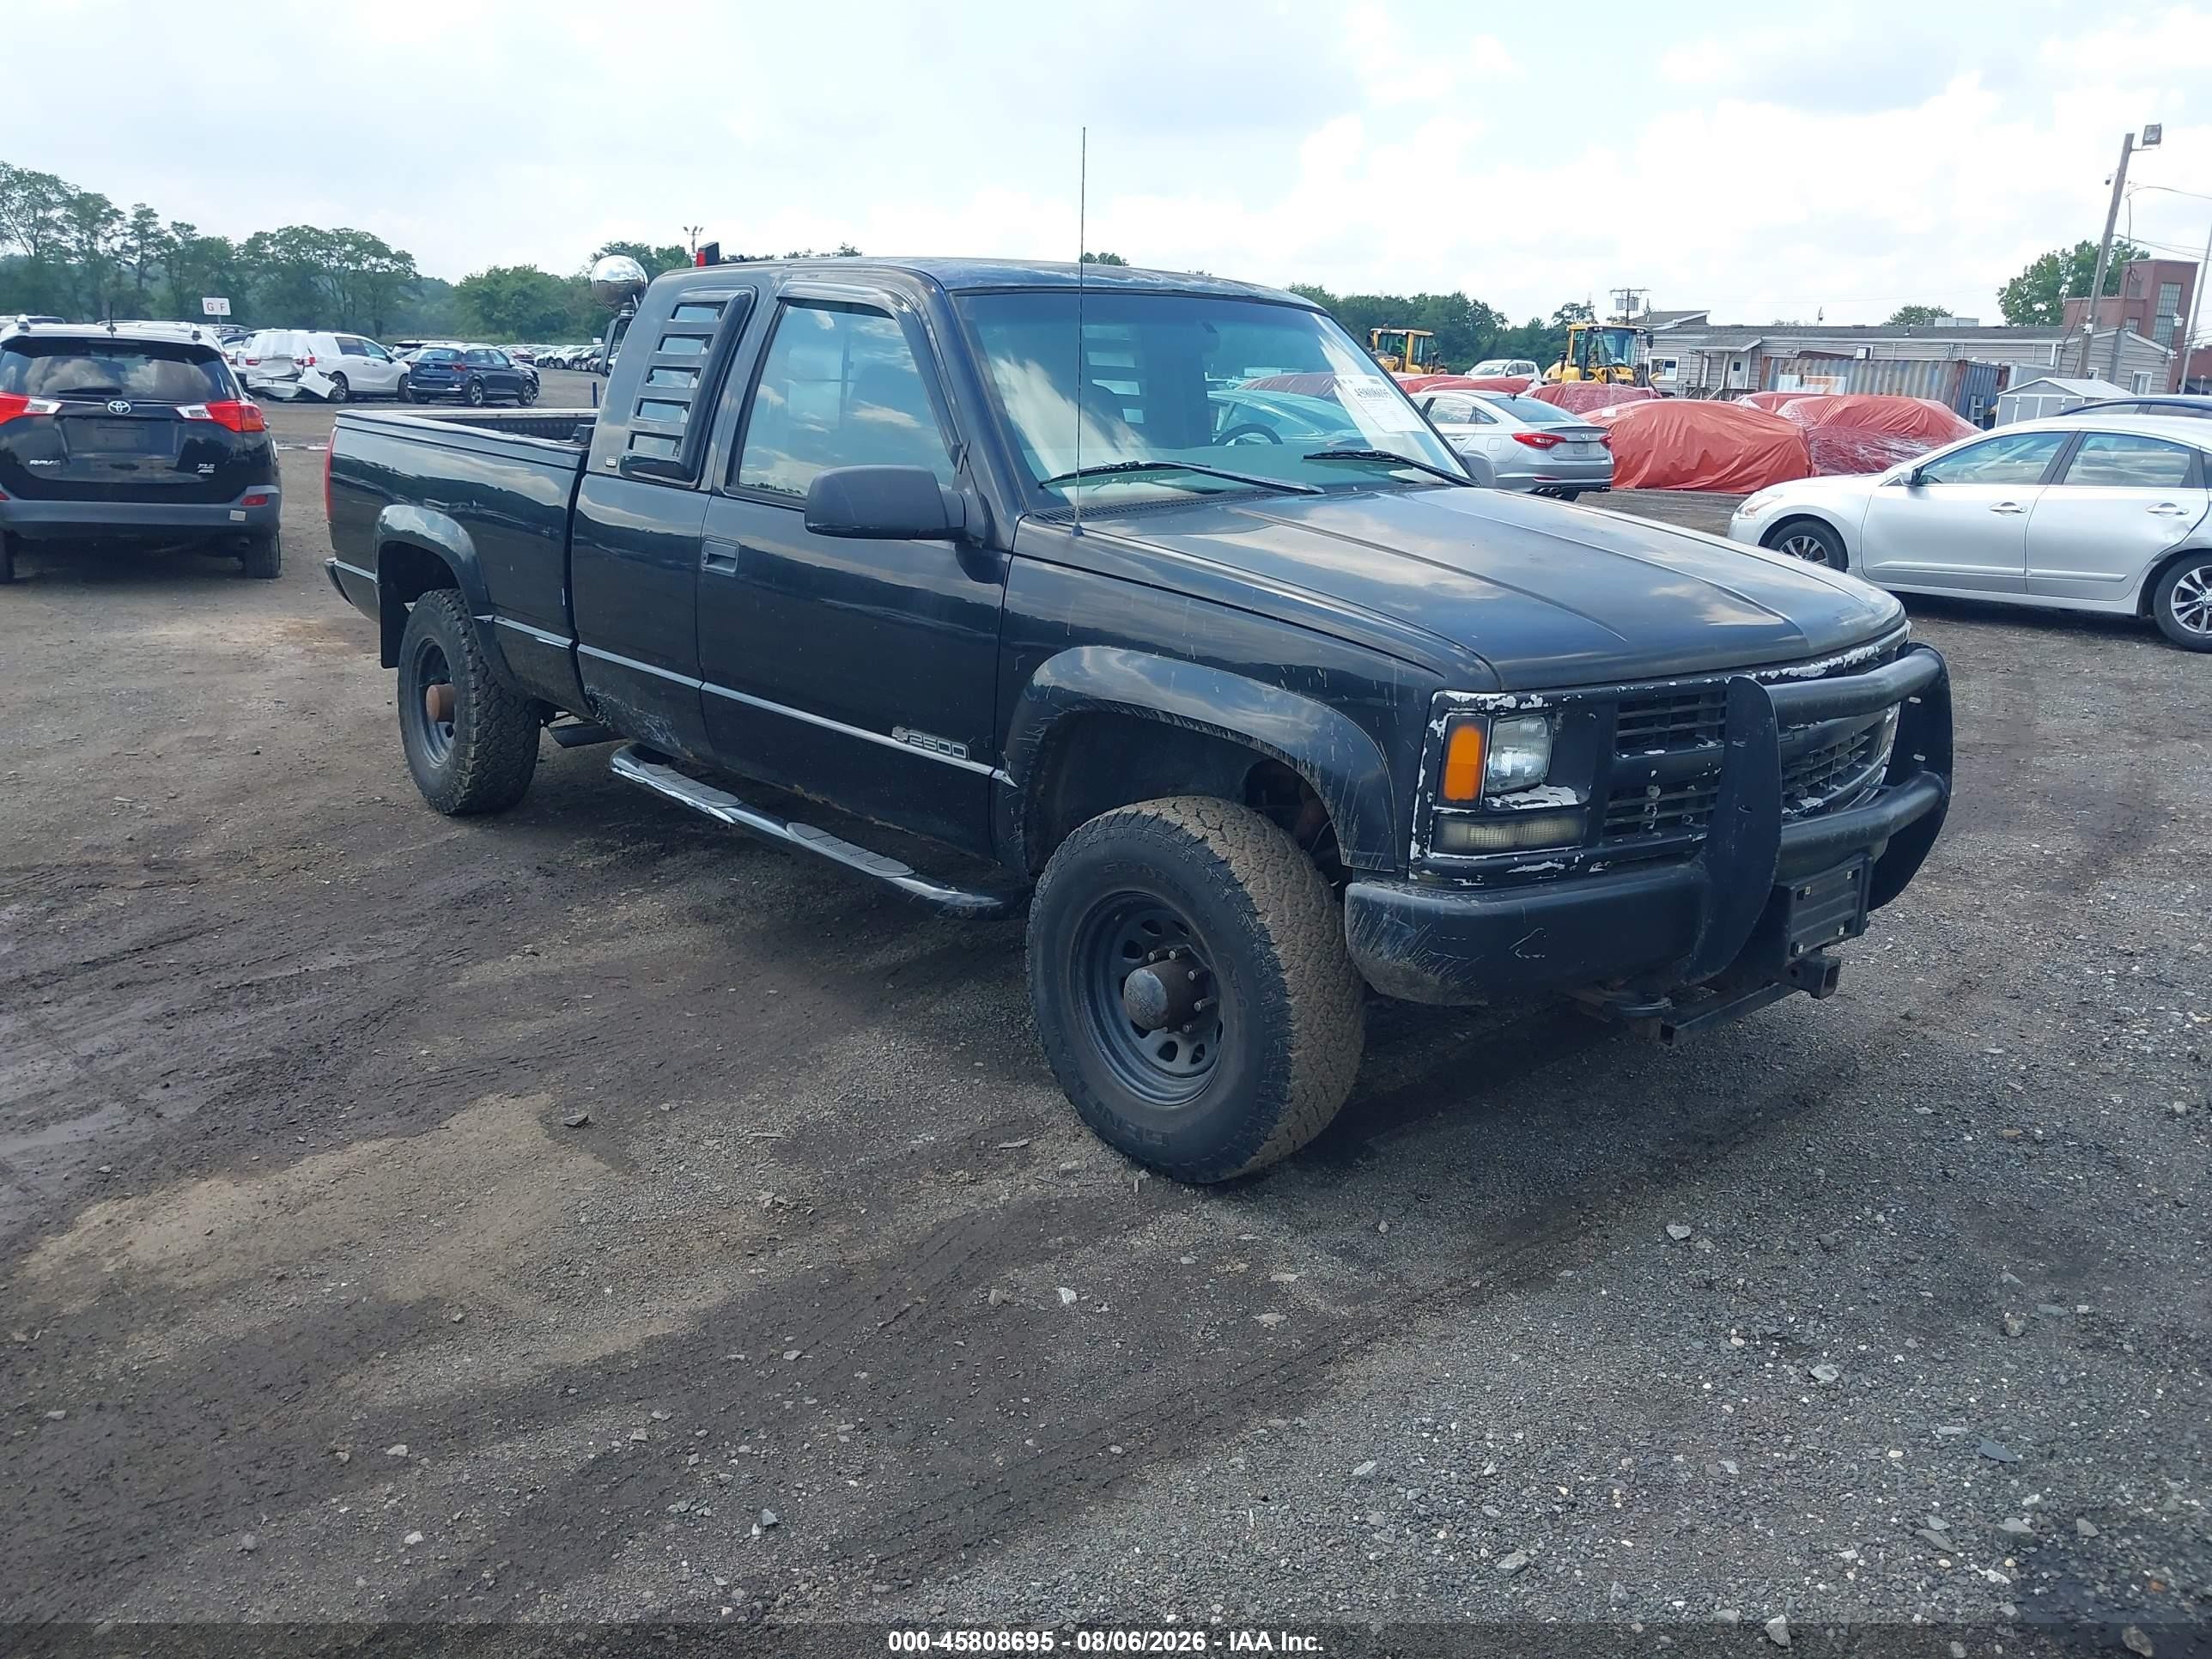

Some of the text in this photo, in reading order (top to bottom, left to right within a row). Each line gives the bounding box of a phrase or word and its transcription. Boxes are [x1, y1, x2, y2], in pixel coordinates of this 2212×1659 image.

[207, 302, 225, 312] G F
[909, 732, 966, 759] 2500
